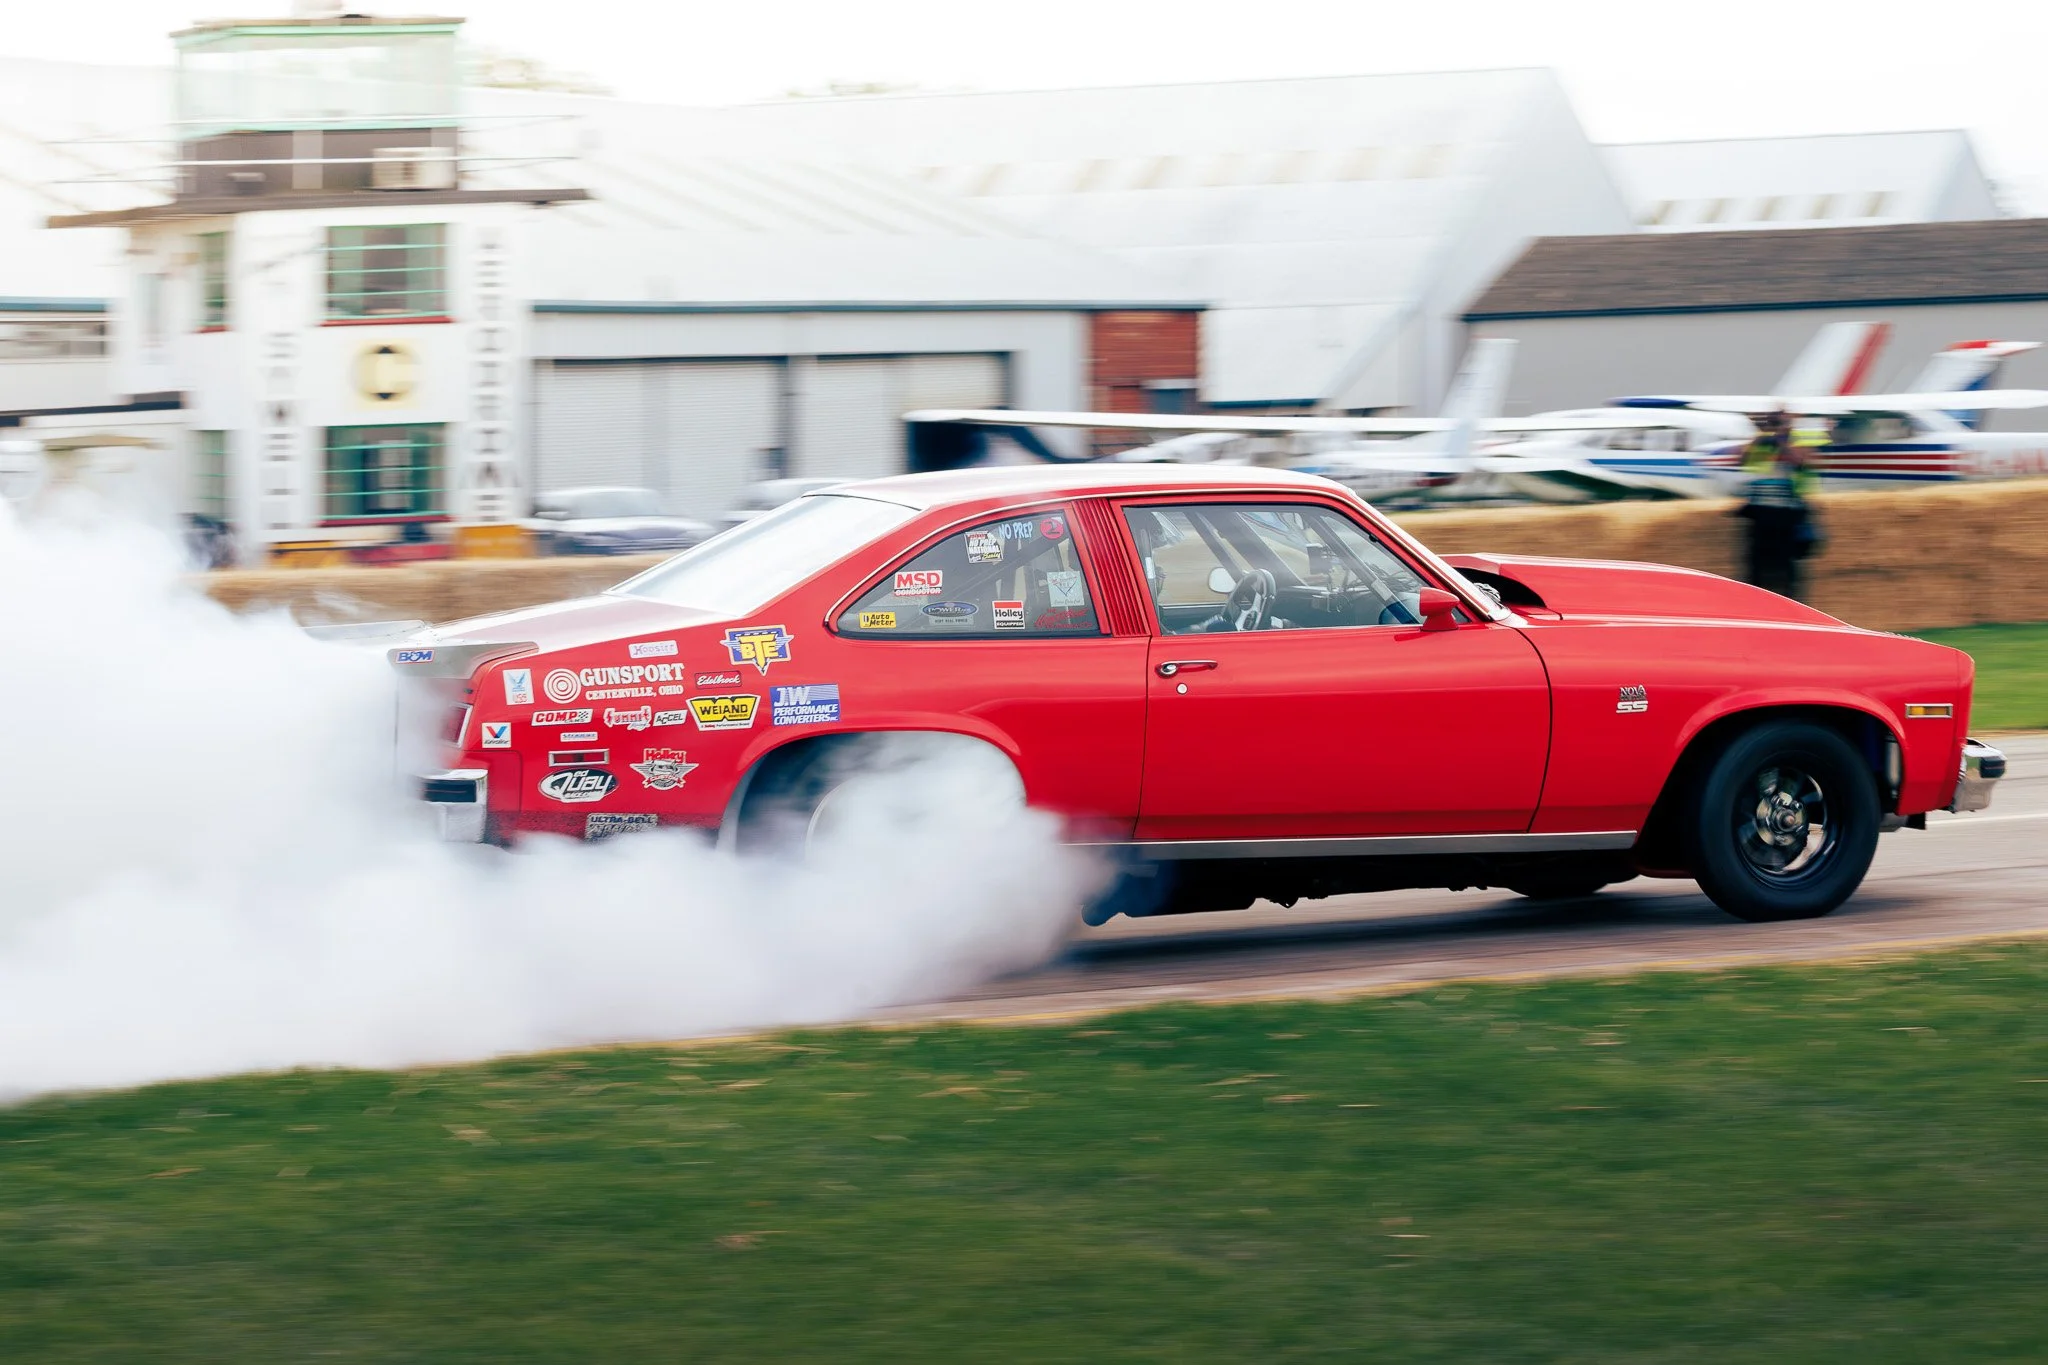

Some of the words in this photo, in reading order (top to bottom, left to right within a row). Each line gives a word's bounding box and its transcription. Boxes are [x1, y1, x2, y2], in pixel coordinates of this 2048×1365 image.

[998, 523, 1011, 541] NO
[1013, 521, 1033, 540] PREP
[969, 539, 979, 547] NO
[979, 538, 996, 546] PREP
[896, 572, 941, 588] MSD
[895, 588, 941, 597] CONDUCTOR
[995, 609, 1023, 619] Holley
[869, 619, 895, 627] Meter
[739, 634, 780, 668] BTE
[579, 663, 684, 687] GUNSPORT
[697, 672, 741, 686] Edelbrock
[658, 685, 684, 695] OHIO
[1620, 684, 1647, 696] NOVA
[774, 687, 812, 706] J.W.
[700, 704, 748, 716] WEIAND
[773, 703, 838, 717] PERFORMANCE
[1616, 700, 1649, 714] SS
[535, 711, 579, 723] COMP
[655, 713, 684, 724] ACCEL
[773, 714, 830, 726] CONVERTERS
[645, 749, 684, 763] Holley
[573, 769, 590, 778] ed
[540, 771, 613, 797] Quay
[591, 815, 653, 824] ULTRA-BELL
